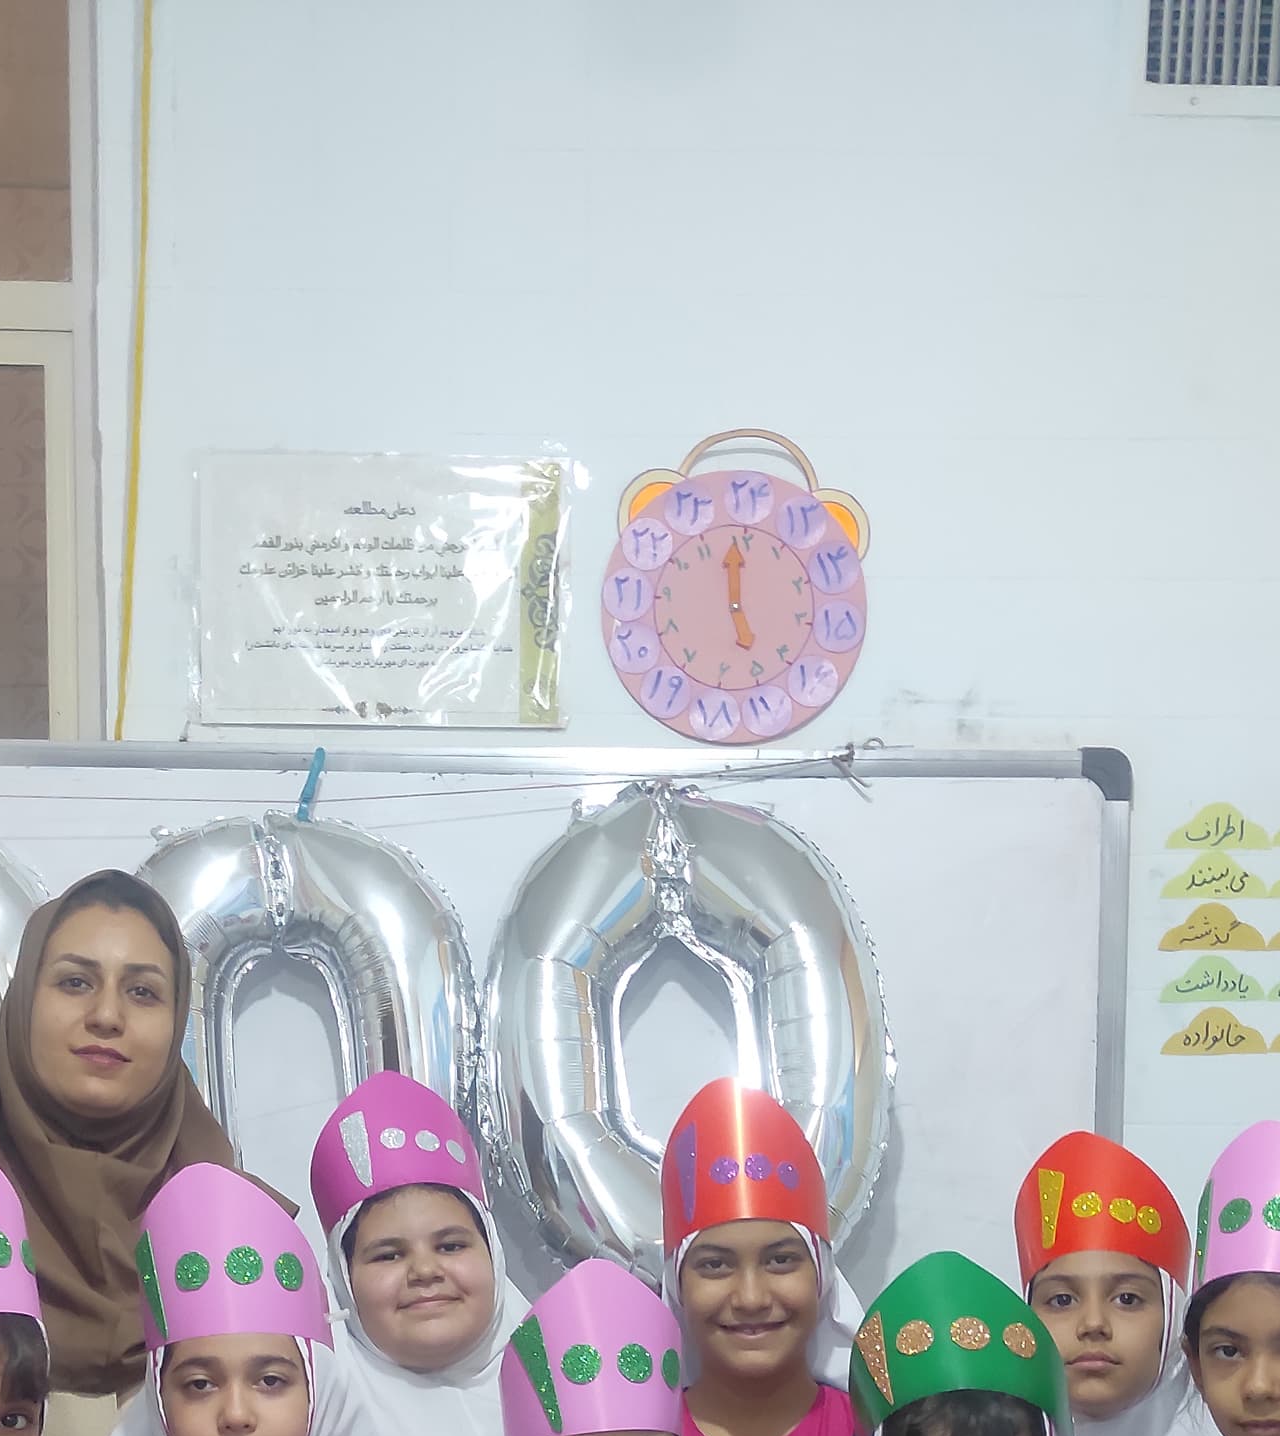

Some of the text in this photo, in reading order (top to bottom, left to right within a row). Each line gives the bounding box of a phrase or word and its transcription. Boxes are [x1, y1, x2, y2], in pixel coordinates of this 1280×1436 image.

[676, 491, 712, 526] ۲۳
[731, 479, 770, 518] ۲۴
[787, 502, 821, 538] ۱۳
[675, 557, 689, 571] ۱۰
[698, 543, 711, 560] ۱۱
[816, 546, 849, 587] ۱۴
[239, 562, 276, 576] علمك
[614, 576, 642, 612] ۲۱
[823, 609, 857, 641] ۱۵
[617, 629, 649, 662] ۲۰
[647, 669, 683, 712] ۱۹
[697, 698, 734, 729] ۱۸
[1185, 813, 1245, 846] اطراف
[1179, 917, 1244, 946] گذشته
[1175, 969, 1250, 999] یادداشت
[1183, 1020, 1247, 1051] خانواده
